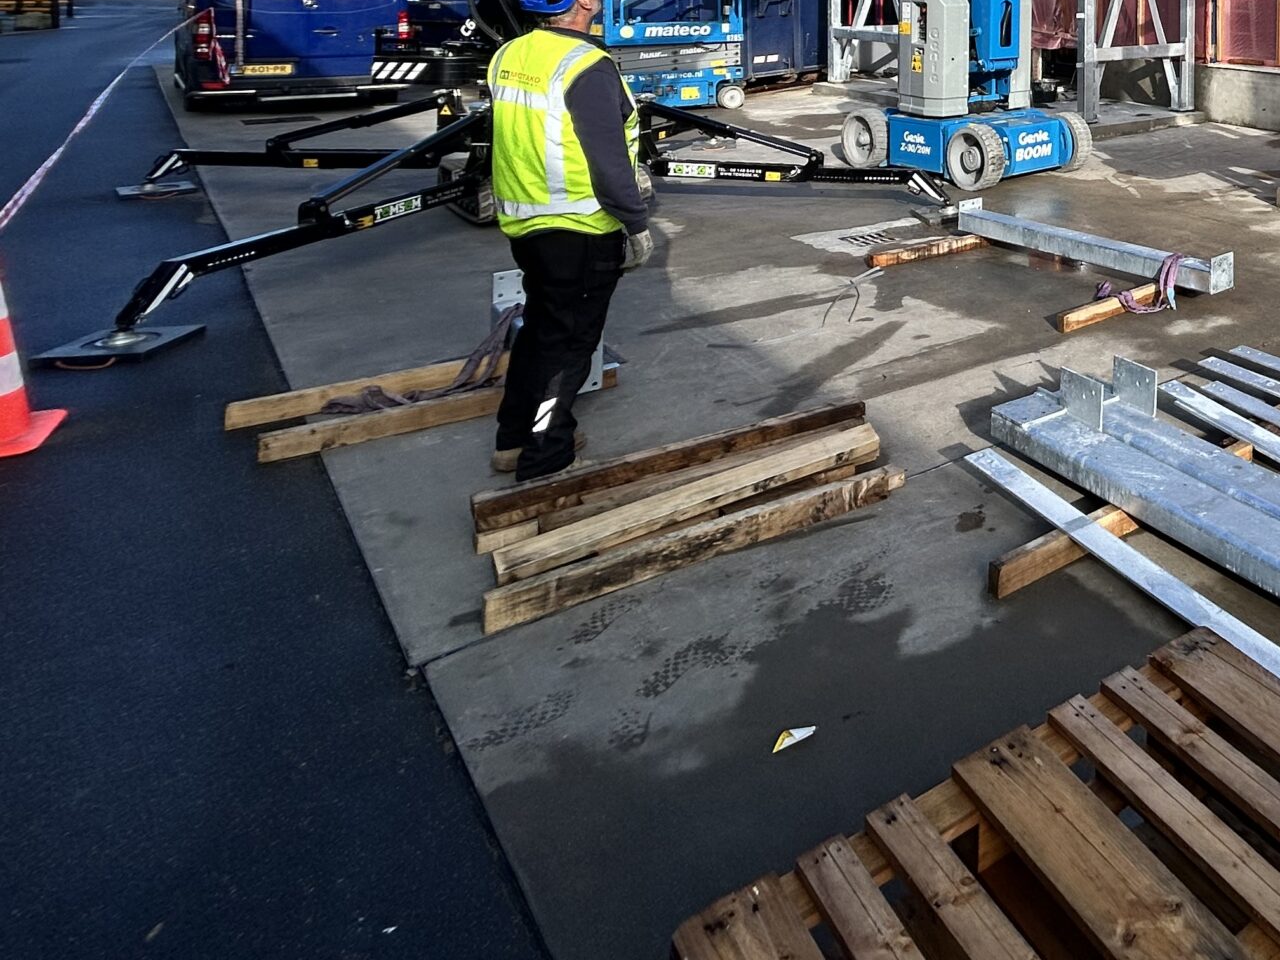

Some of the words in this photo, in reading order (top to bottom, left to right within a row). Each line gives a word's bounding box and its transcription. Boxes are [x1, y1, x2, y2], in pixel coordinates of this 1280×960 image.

[644, 25, 711, 38] mateco
[903, 131, 926, 144] Genie
[1018, 130, 1050, 146] Genie
[1015, 143, 1053, 162] BOOM
[374, 195, 421, 223] TOMSOM
